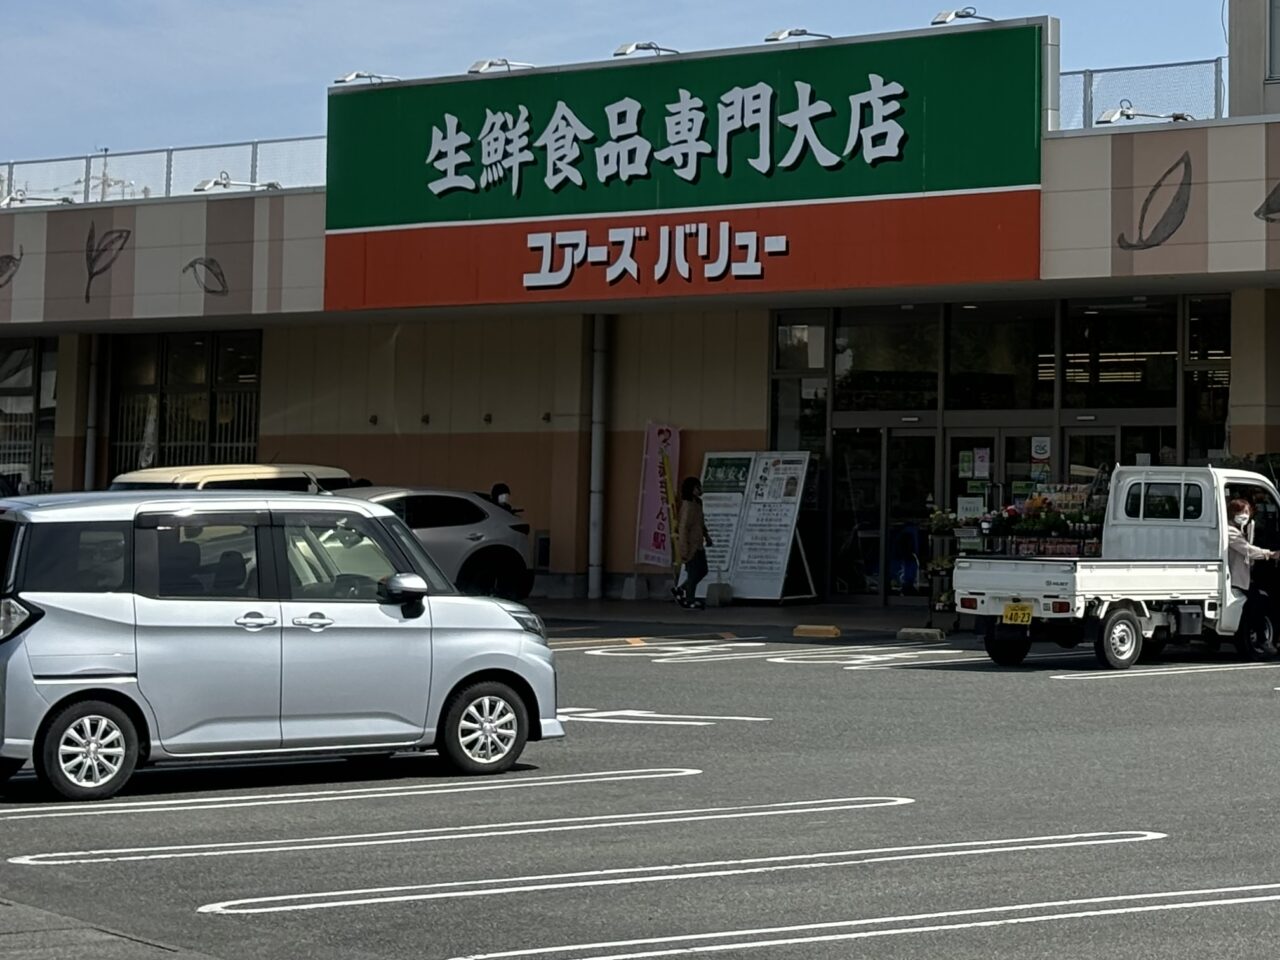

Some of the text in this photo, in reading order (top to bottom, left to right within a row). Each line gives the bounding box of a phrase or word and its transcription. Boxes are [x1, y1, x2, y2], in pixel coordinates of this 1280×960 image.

[425, 74, 906, 197] 生鮮食品専門大店
